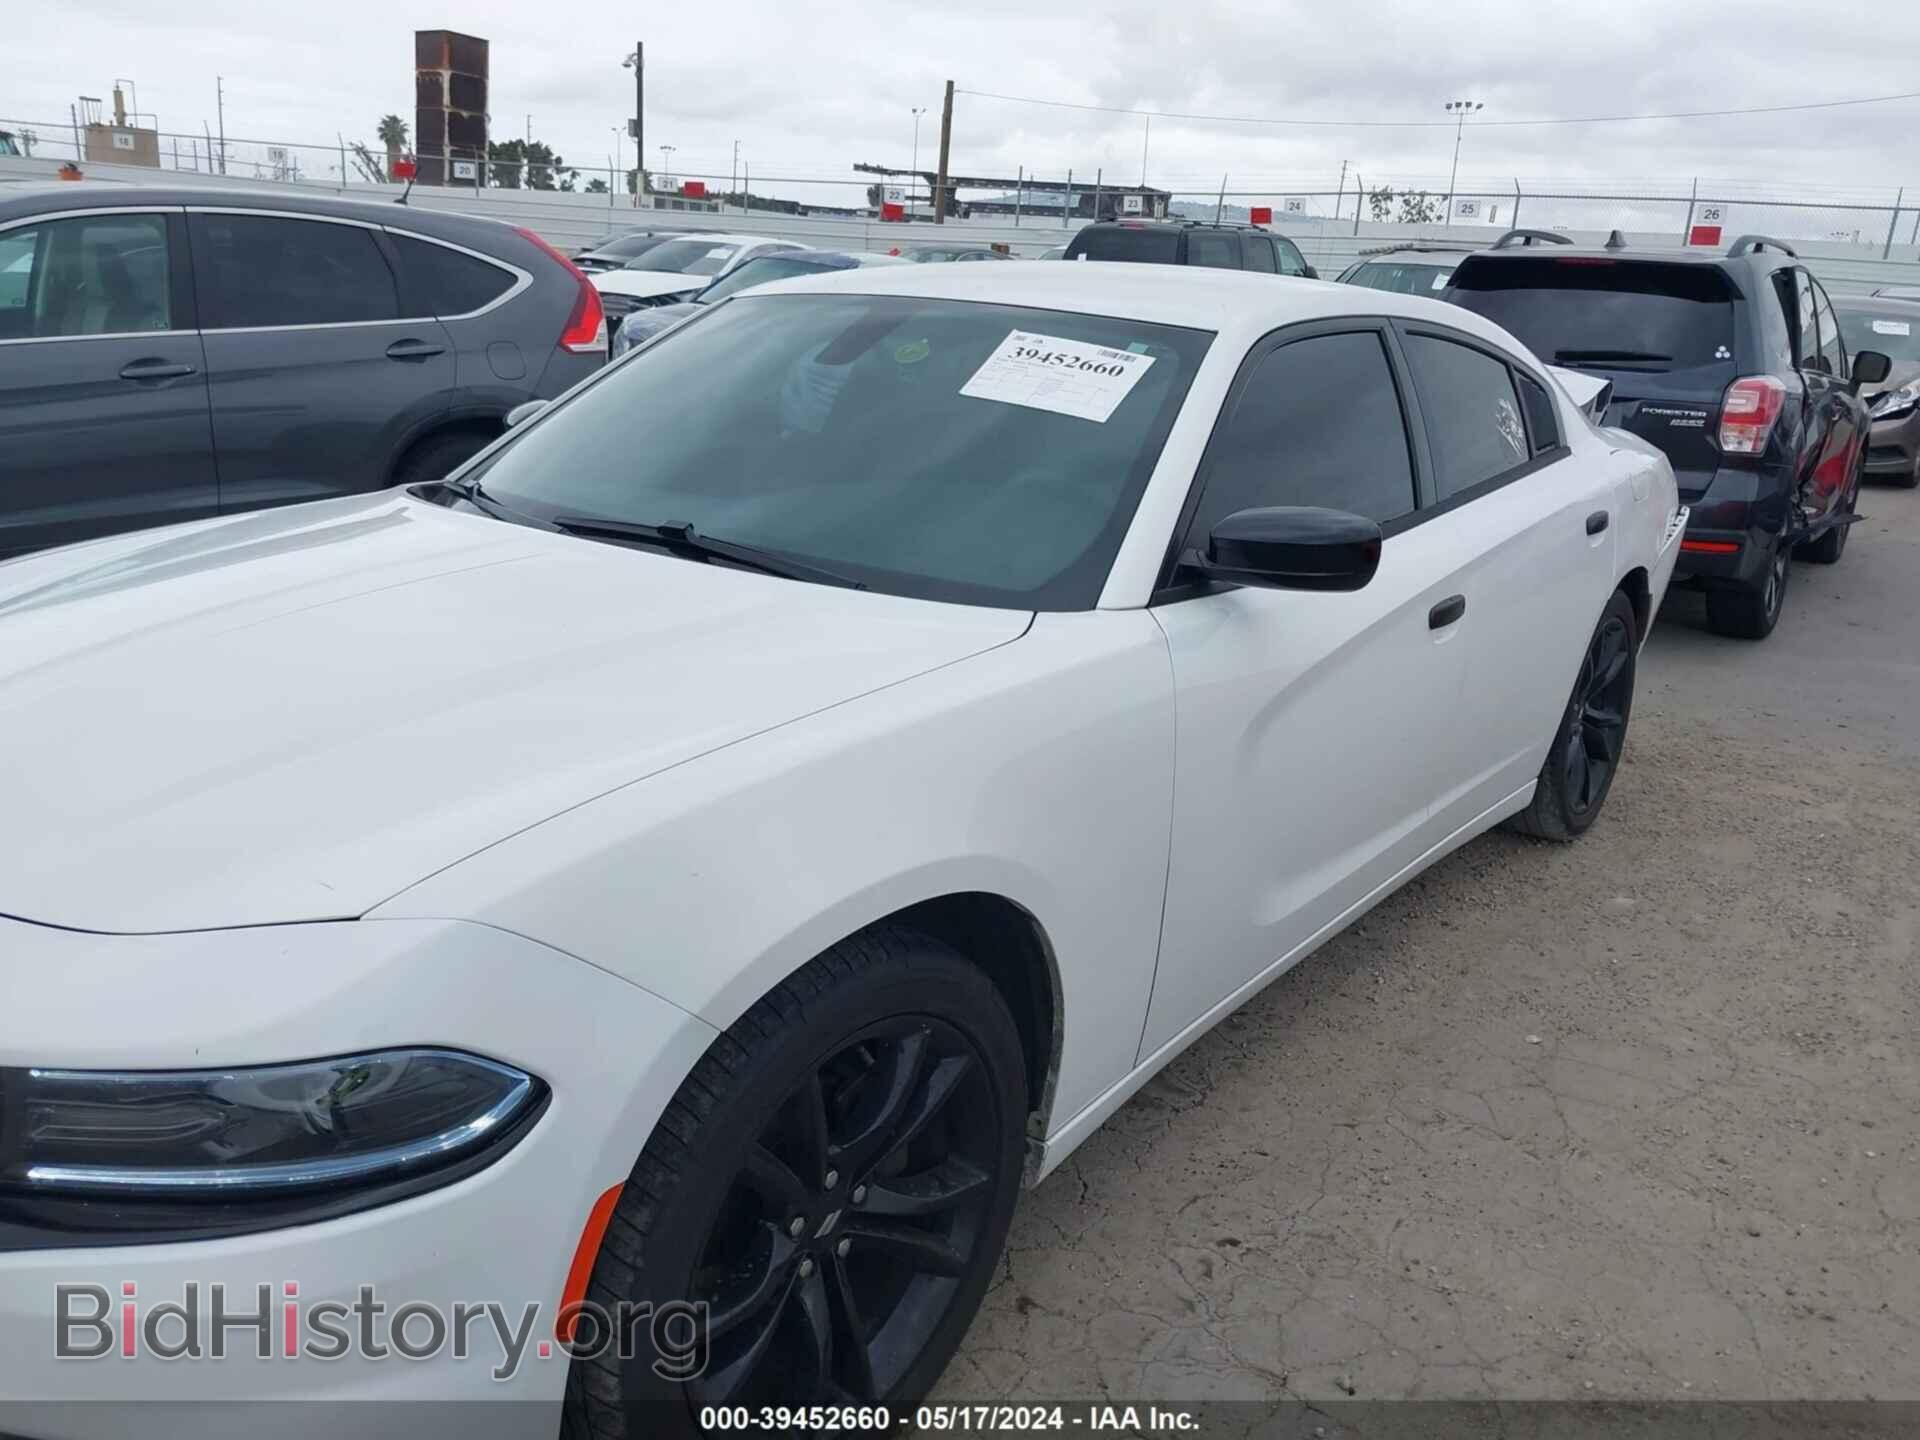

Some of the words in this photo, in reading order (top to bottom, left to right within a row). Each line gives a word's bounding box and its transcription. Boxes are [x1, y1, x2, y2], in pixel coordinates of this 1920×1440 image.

[459, 167, 471, 175] 20
[664, 181, 673, 189] 21
[889, 191, 900, 199] 22
[1128, 200, 1138, 208] 23
[1289, 202, 1301, 211] 24
[1461, 204, 1474, 213] 25
[1704, 209, 1720, 220] 26
[1009, 346, 1124, 377] 39452660
